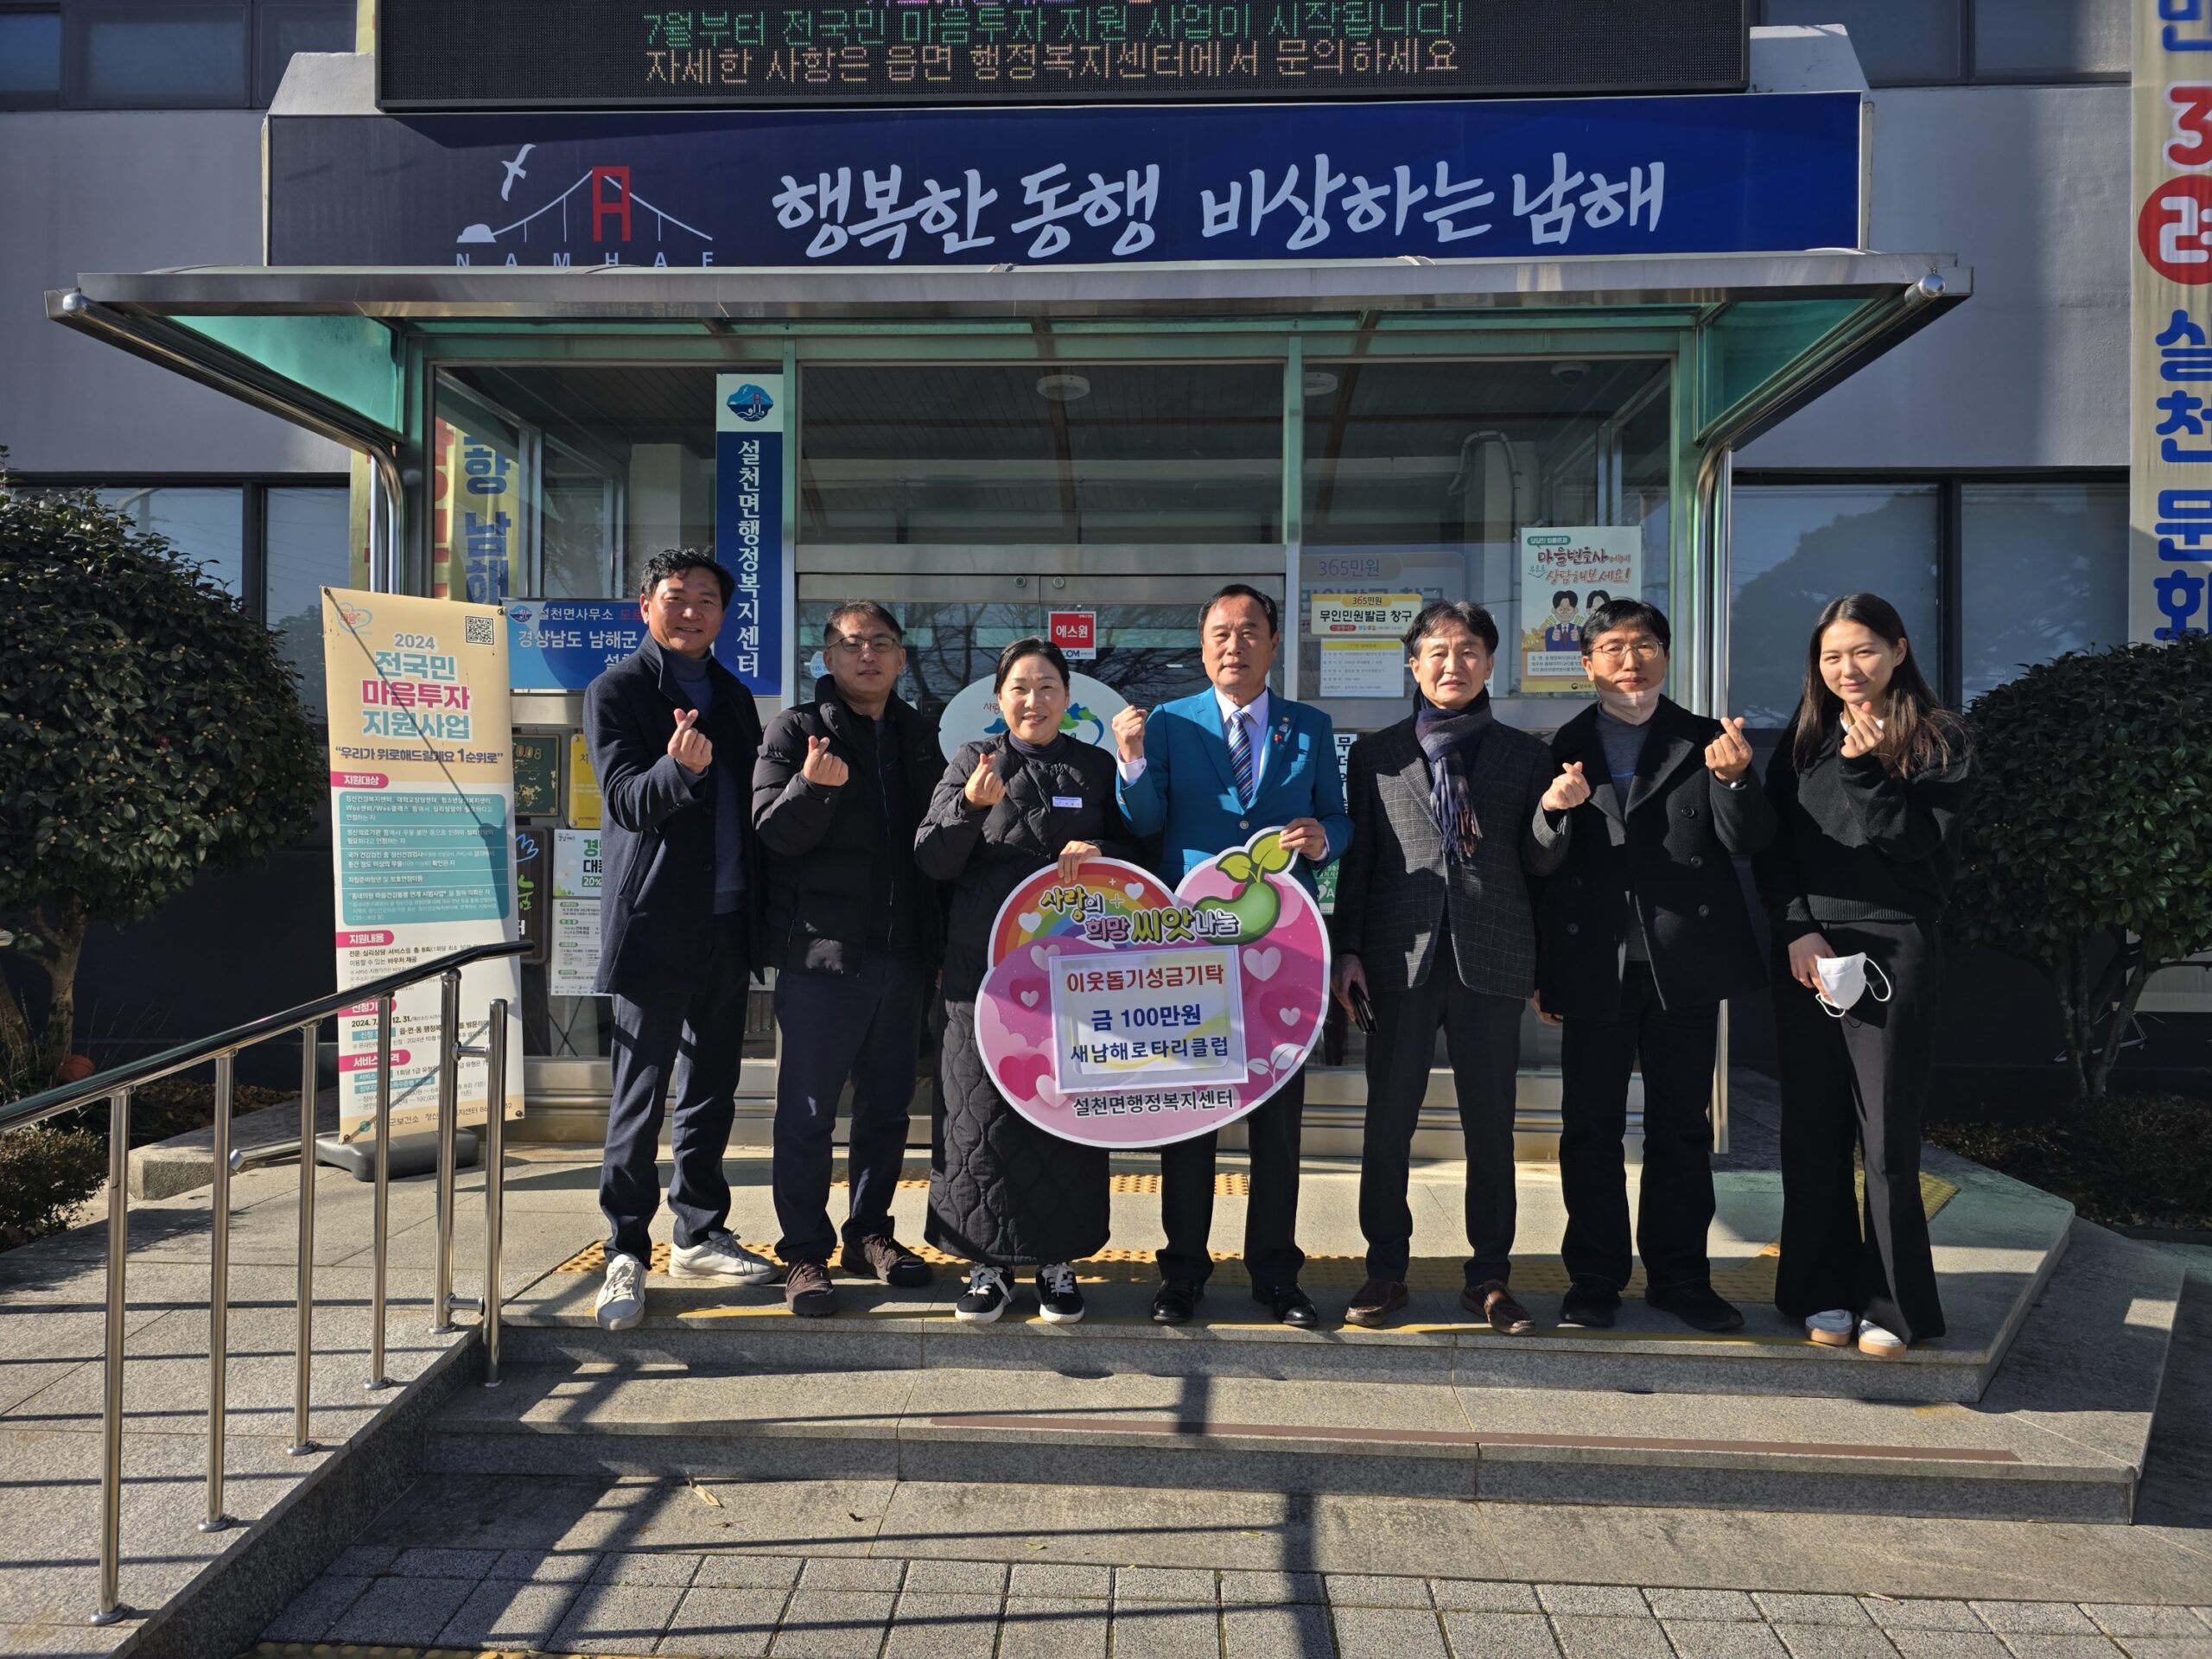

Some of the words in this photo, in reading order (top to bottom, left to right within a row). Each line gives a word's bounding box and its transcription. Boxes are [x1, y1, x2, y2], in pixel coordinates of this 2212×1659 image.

[643, 10, 765, 47] 7월부터
[783, 9, 885, 46] 전국민
[901, 8, 1047, 44] 마음투자
[1059, 6, 1126, 41] 지원
[1145, 3, 1249, 41] 사업이
[1268, 1, 1463, 37] 시작됩니다!
[645, 48, 753, 85] 자세한
[766, 47, 870, 84] 사항은
[886, 45, 951, 81] 읍면
[969, 41, 1259, 80] 행정복지센터에서
[1275, 38, 1459, 76] 문의하세요
[772, 164, 999, 259] 행복한
[1010, 162, 1160, 258] 동행
[1200, 154, 1496, 251] 비상하는
[1511, 152, 1665, 245] 남해
[737, 439, 761, 678] 설천면행정복지센터
[538, 607, 614, 621] 설천면사무소
[1351, 596, 1382, 606] 365민원
[1319, 610, 1386, 622] 무인민원발급
[1390, 610, 1413, 623] 창구
[394, 632, 435, 651] 2024
[518, 630, 583, 648] 경상남도
[588, 630, 638, 649] 남해군
[1056, 625, 1089, 638] 에스원
[375, 651, 457, 681] 전국민
[604, 653, 631, 670] 설
[361, 679, 471, 710] 마음투자
[361, 710, 470, 740] 지원사업
[343, 774, 379, 785] 지원대상
[1041, 886, 1104, 923] 사랑의
[349, 933, 385, 944] 지원내용
[1084, 915, 1131, 942] 희망
[1066, 963, 1224, 994] 이웃돕기성금기탁
[1091, 1009, 1113, 1032] 금
[1121, 1003, 1202, 1029] 100만원
[1070, 1035, 1229, 1065] 새남해로타리클럽
[1072, 1090, 1234, 1118] 설천면행정복지센터
